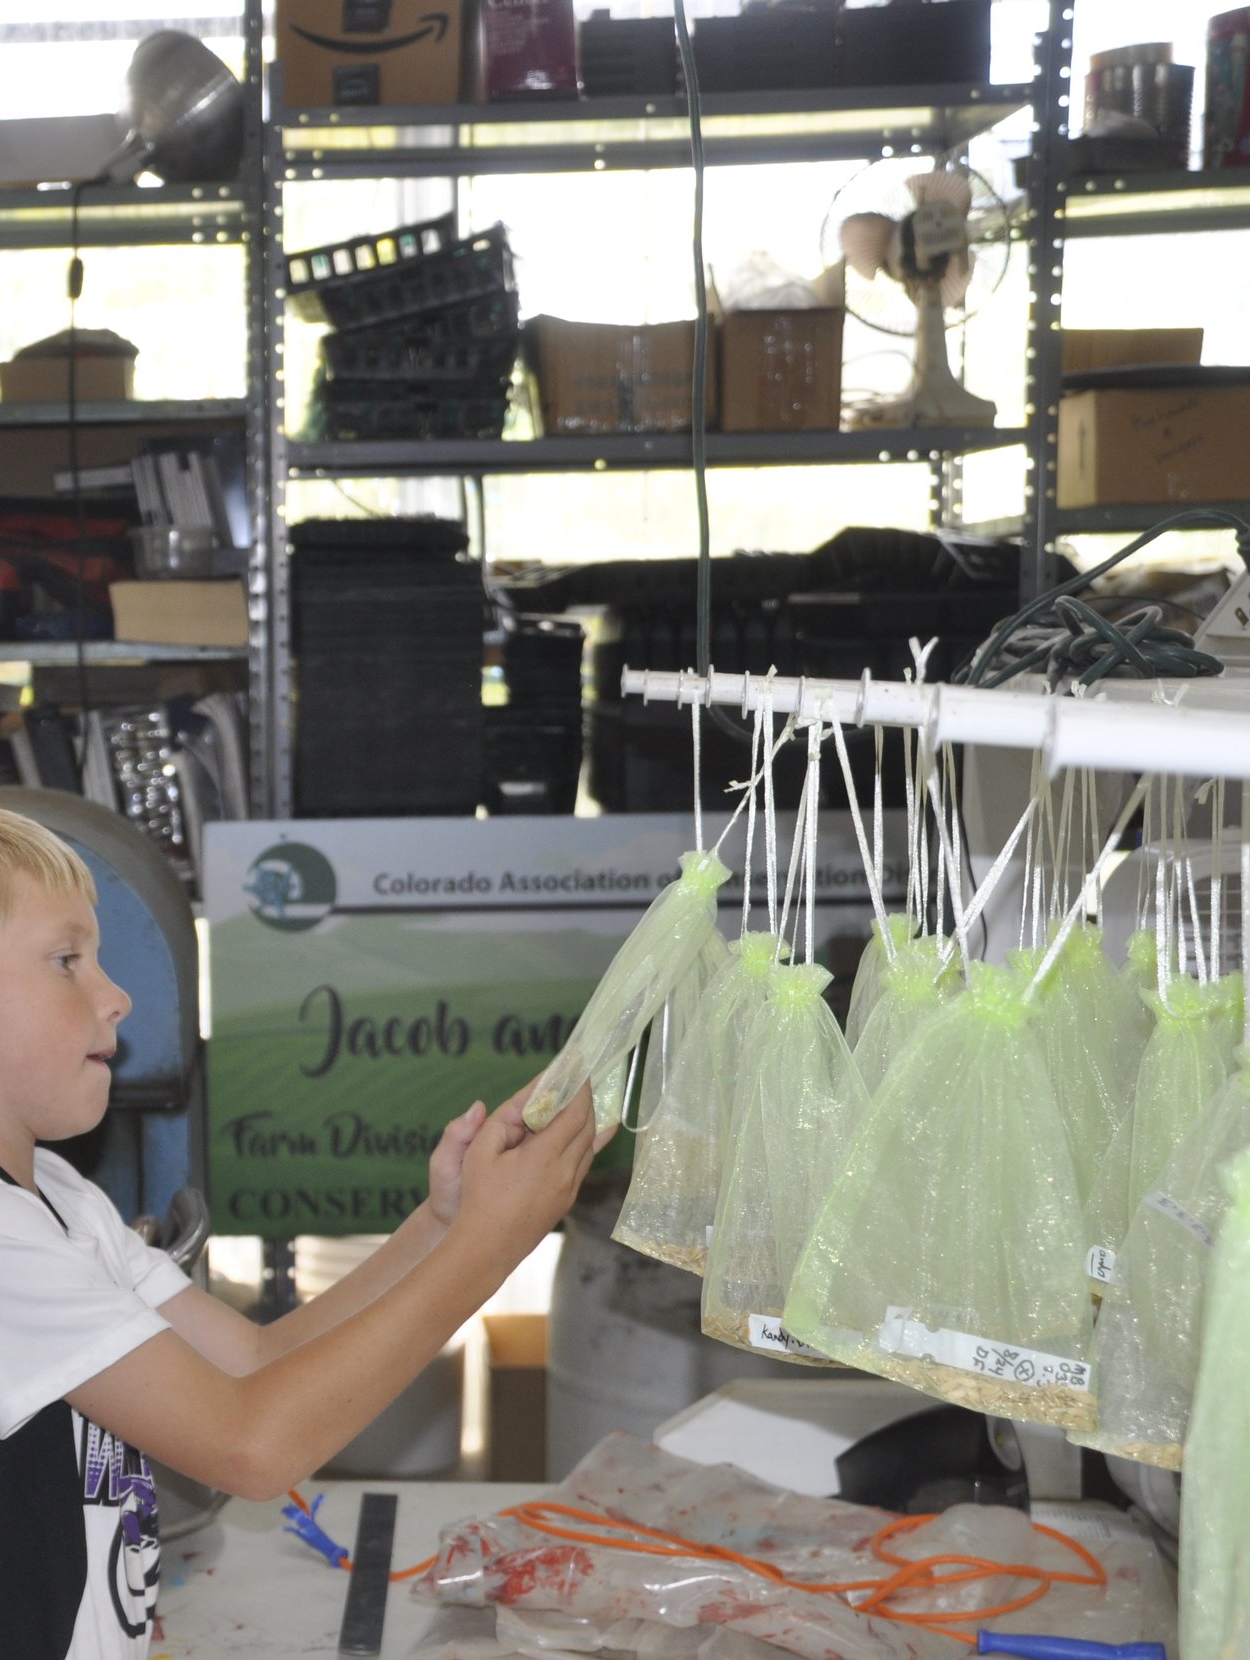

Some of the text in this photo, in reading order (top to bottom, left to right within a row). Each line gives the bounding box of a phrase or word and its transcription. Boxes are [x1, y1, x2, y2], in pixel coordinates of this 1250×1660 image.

[372, 871, 492, 896] Colorado
[499, 869, 649, 893] Association
[298, 984, 582, 1078] Jacob an
[222, 1110, 318, 1158] Farm
